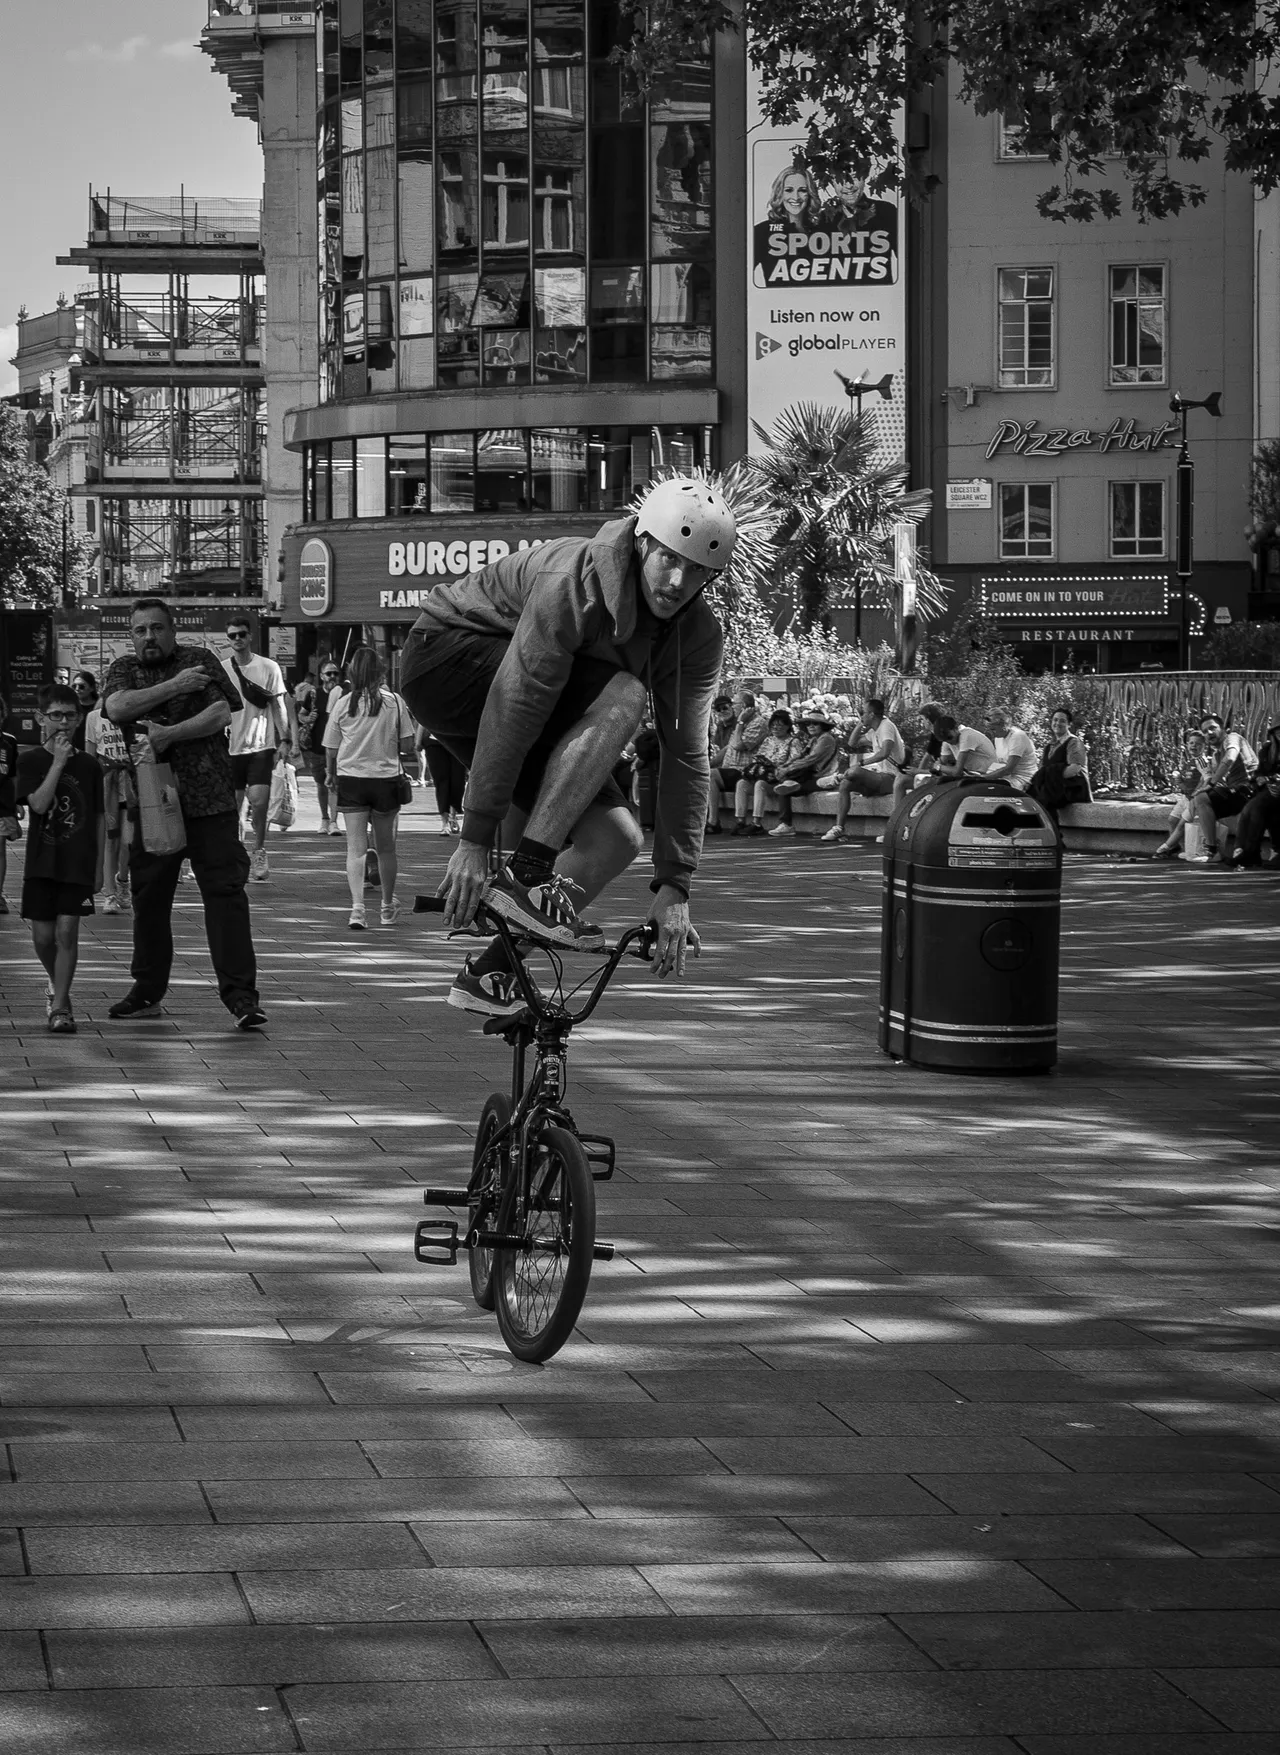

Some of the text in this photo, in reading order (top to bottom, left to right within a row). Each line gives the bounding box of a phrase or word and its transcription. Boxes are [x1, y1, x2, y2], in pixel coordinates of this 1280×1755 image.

[769, 223, 784, 232] THE
[768, 230, 890, 256] SPORTS
[768, 257, 888, 282] AGENTS
[770, 309, 880, 323] Listen now on
[985, 417, 1180, 459] Pizza Hut
[950, 486, 981, 494] LEICESTER
[991, 592, 1023, 603] COME
[1025, 592, 1041, 602] ON
[1044, 592, 1055, 602] IN
[1058, 592, 1071, 602] TO
[1075, 591, 1104, 602] YOUR
[1021, 630, 1135, 641] RESTAURANT
[10, 670, 43, 681] To Let
